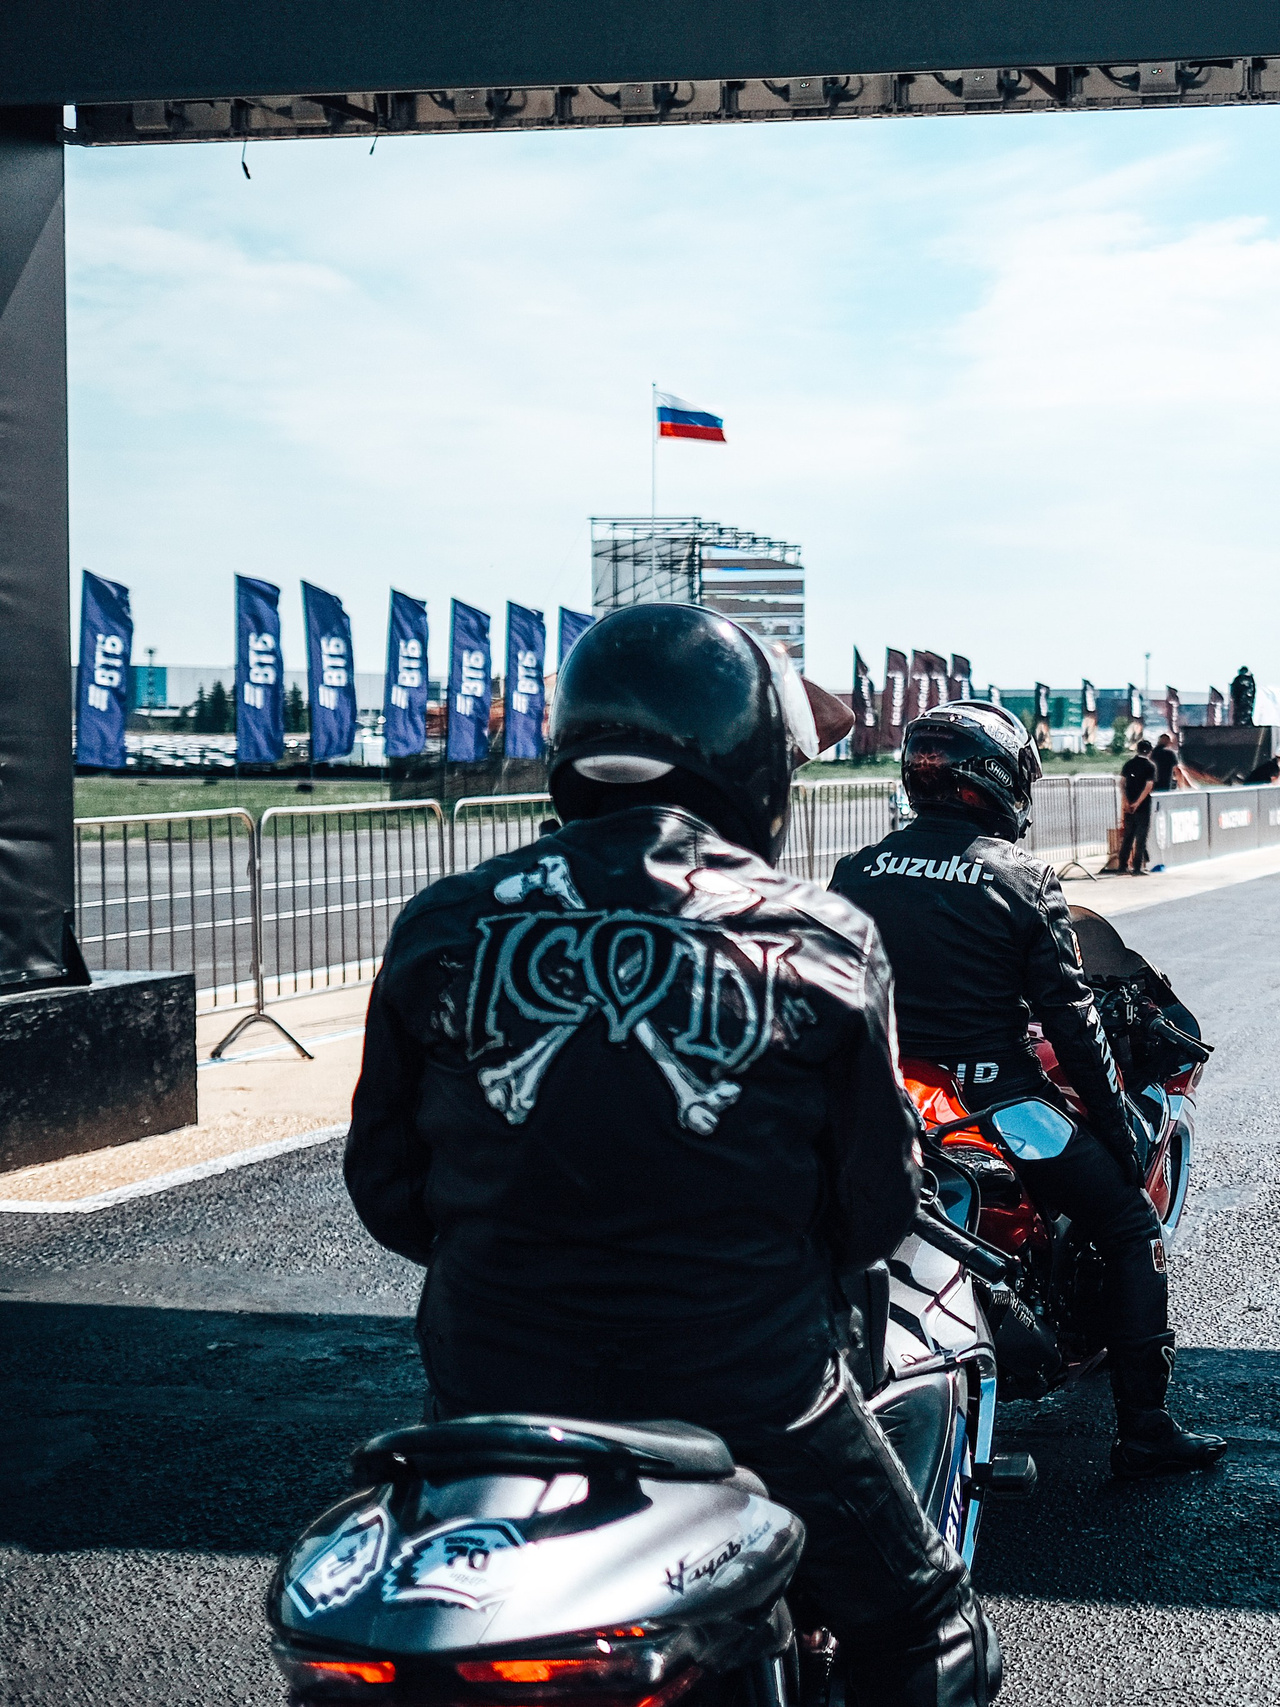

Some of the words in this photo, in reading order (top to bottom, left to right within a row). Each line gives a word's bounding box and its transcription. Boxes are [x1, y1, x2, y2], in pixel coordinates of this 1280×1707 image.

[94, 633, 124, 688] ВТБ
[248, 632, 277, 685] ВТБ
[320, 636, 348, 687] ВТБ
[398, 638, 423, 688] ВТБ
[461, 650, 486, 697] ВТБ
[517, 650, 540, 695] ВТБ
[988, 762, 1010, 784] SHOEI
[466, 908, 800, 1077] ICON
